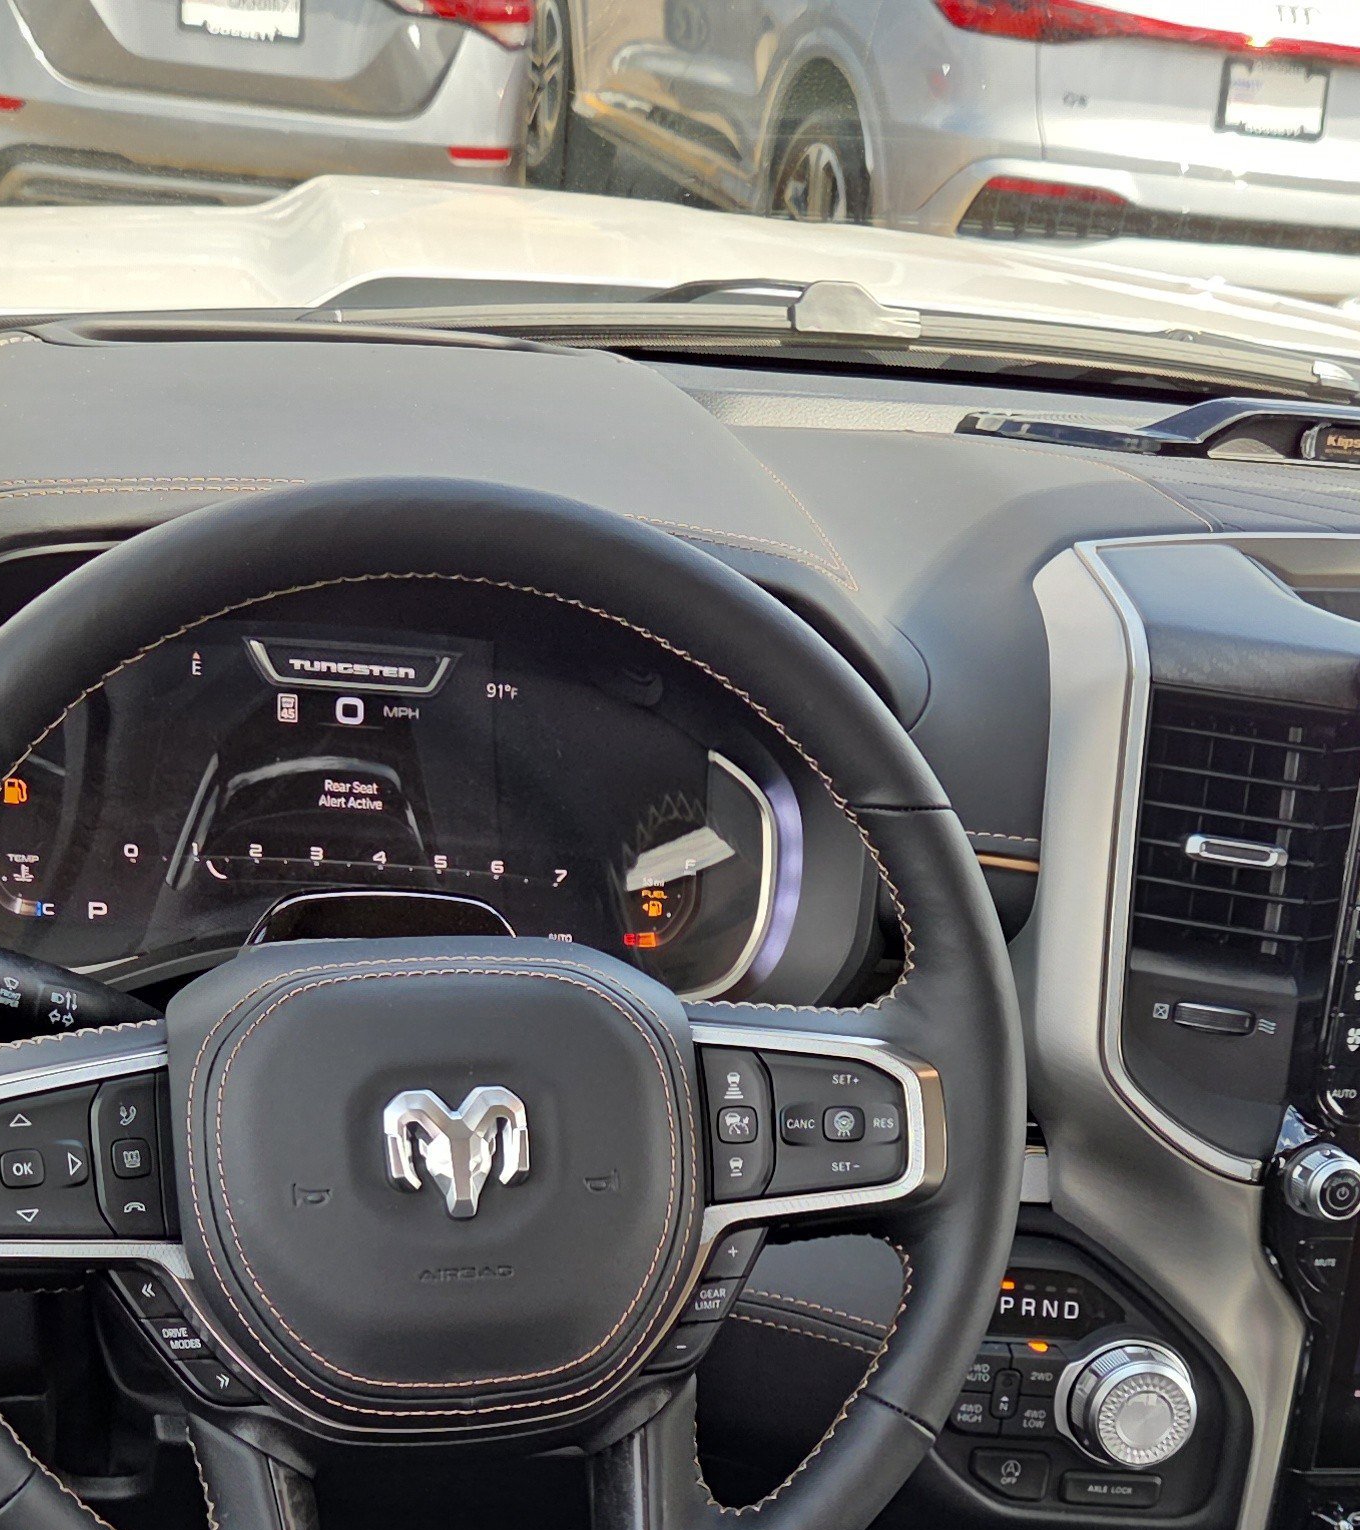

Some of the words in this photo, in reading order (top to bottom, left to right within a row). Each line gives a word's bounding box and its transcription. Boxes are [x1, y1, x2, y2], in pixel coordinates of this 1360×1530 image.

[192, 660, 202, 675] E
[383, 705, 420, 720] MPH
[324, 779, 350, 794] Rear
[352, 781, 378, 795] Seat
[318, 795, 346, 809] Alert
[347, 796, 383, 811] Active
[249, 843, 263, 858] 2
[310, 846, 324, 860] 3
[372, 850, 387, 864] 4
[6, 853, 39, 863] TEMP
[434, 855, 448, 869] 5
[490, 860, 505, 874] 6
[554, 869, 568, 883] 7
[42, 903, 55, 916] C
[88, 901, 108, 919] P
[1331, 1088, 1357, 1099] AUTO
[786, 1118, 815, 1130] CANC
[873, 1117, 894, 1129] RES
[12, 1161, 34, 1176] OK
[419, 1265, 515, 1281] AIRBAG
[699, 1288, 726, 1300] GEAR
[695, 1298, 721, 1310] LIMIT
[1000, 1296, 1015, 1315] P
[1021, 1298, 1036, 1317] R
[1042, 1299, 1059, 1318] N
[1064, 1300, 1080, 1320] D
[162, 1327, 189, 1340] DRIVE
[170, 1336, 202, 1350] MODES
[1030, 1372, 1053, 1382] 2WD
[959, 1404, 982, 1414] 4WD
[1024, 1409, 1047, 1419] 4WD
[1023, 1418, 1046, 1429] LOW
